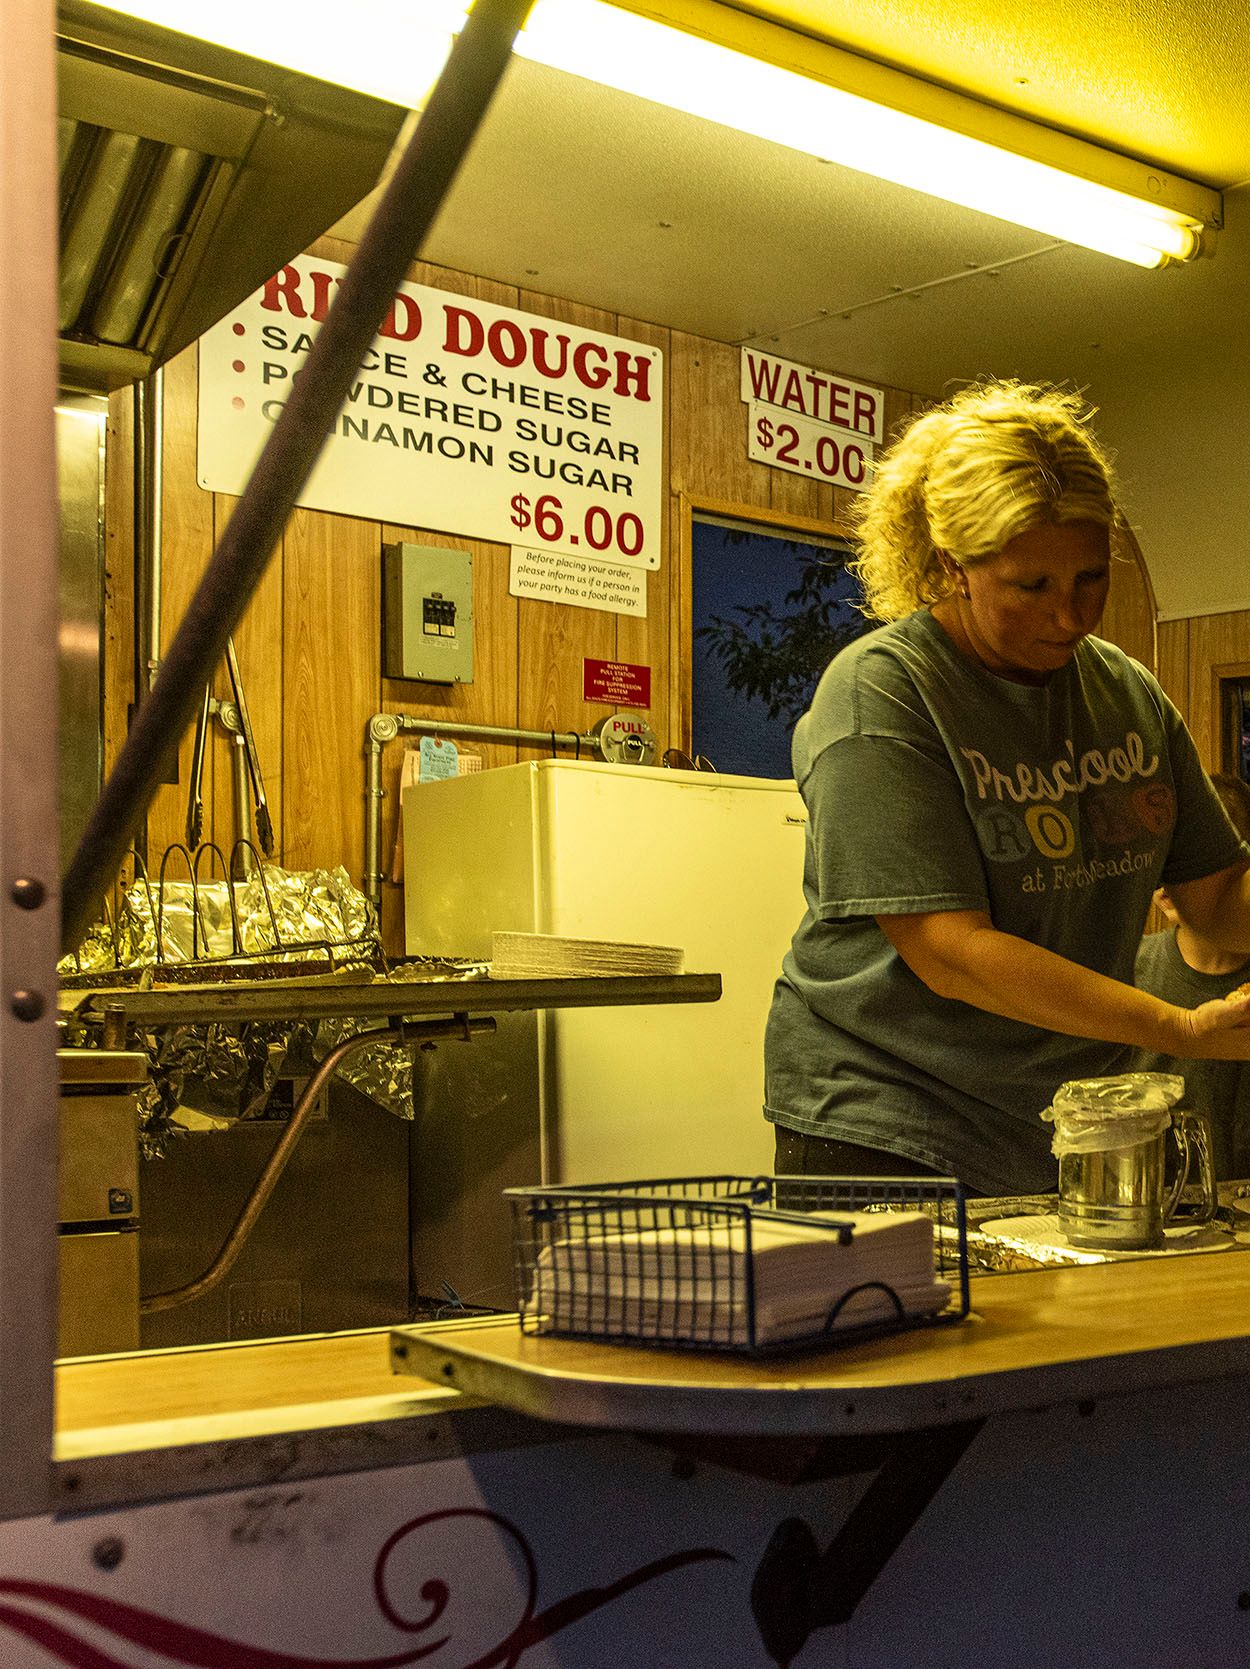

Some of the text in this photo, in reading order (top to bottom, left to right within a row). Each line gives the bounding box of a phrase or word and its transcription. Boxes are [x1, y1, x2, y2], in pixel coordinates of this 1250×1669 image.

[442, 304, 651, 401] DOUGH
[261, 325, 612, 427] SACE & CHEESE
[747, 353, 876, 437] WATER
[261, 400, 633, 498] CNAMON SUGAR
[516, 418, 640, 466] SUGAR
[757, 417, 866, 484] $2.00
[510, 492, 645, 557] $6.00
[517, 565, 640, 594] please inform us if a person in
[526, 551, 632, 580] Before placing your order,
[518, 579, 639, 607] your party has a food allergy.
[600, 668, 636, 679] PULL STATION
[607, 663, 629, 672] REMOTE
[593, 679, 605, 687] FIRE
[613, 721, 645, 734] PULL
[1021, 866, 1046, 894] at
